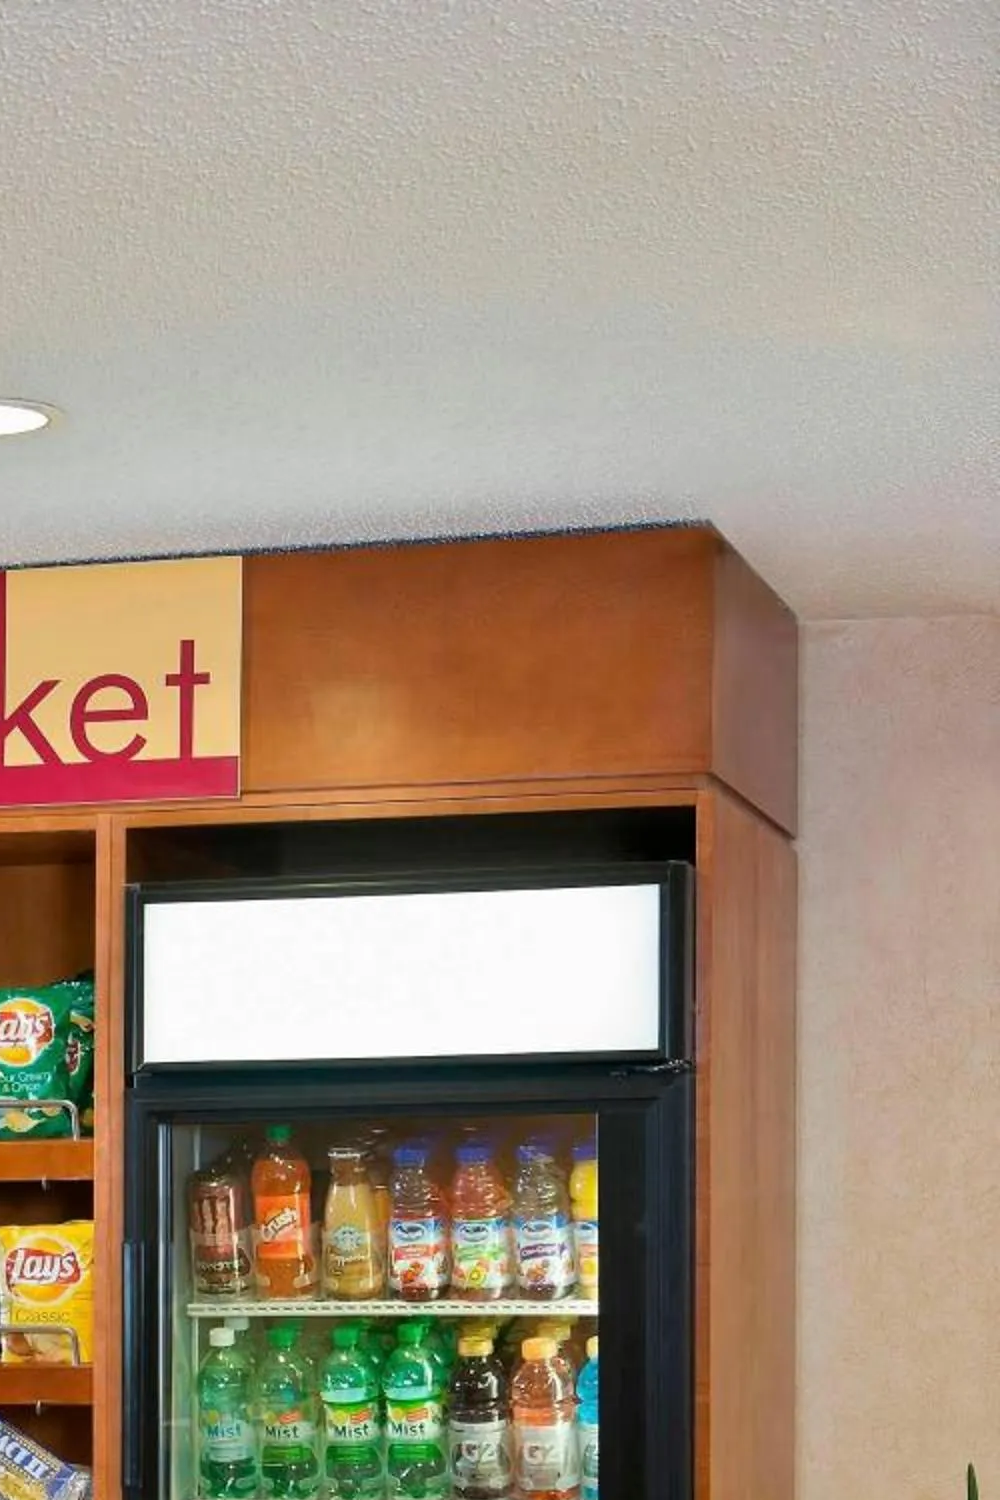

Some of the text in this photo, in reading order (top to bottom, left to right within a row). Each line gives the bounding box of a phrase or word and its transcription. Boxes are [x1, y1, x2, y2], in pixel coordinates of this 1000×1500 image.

[208, 1424, 241, 1439] Mist
[265, 1424, 300, 1439] Mist
[334, 1423, 369, 1439] Mist
[391, 1422, 425, 1437] Mist
